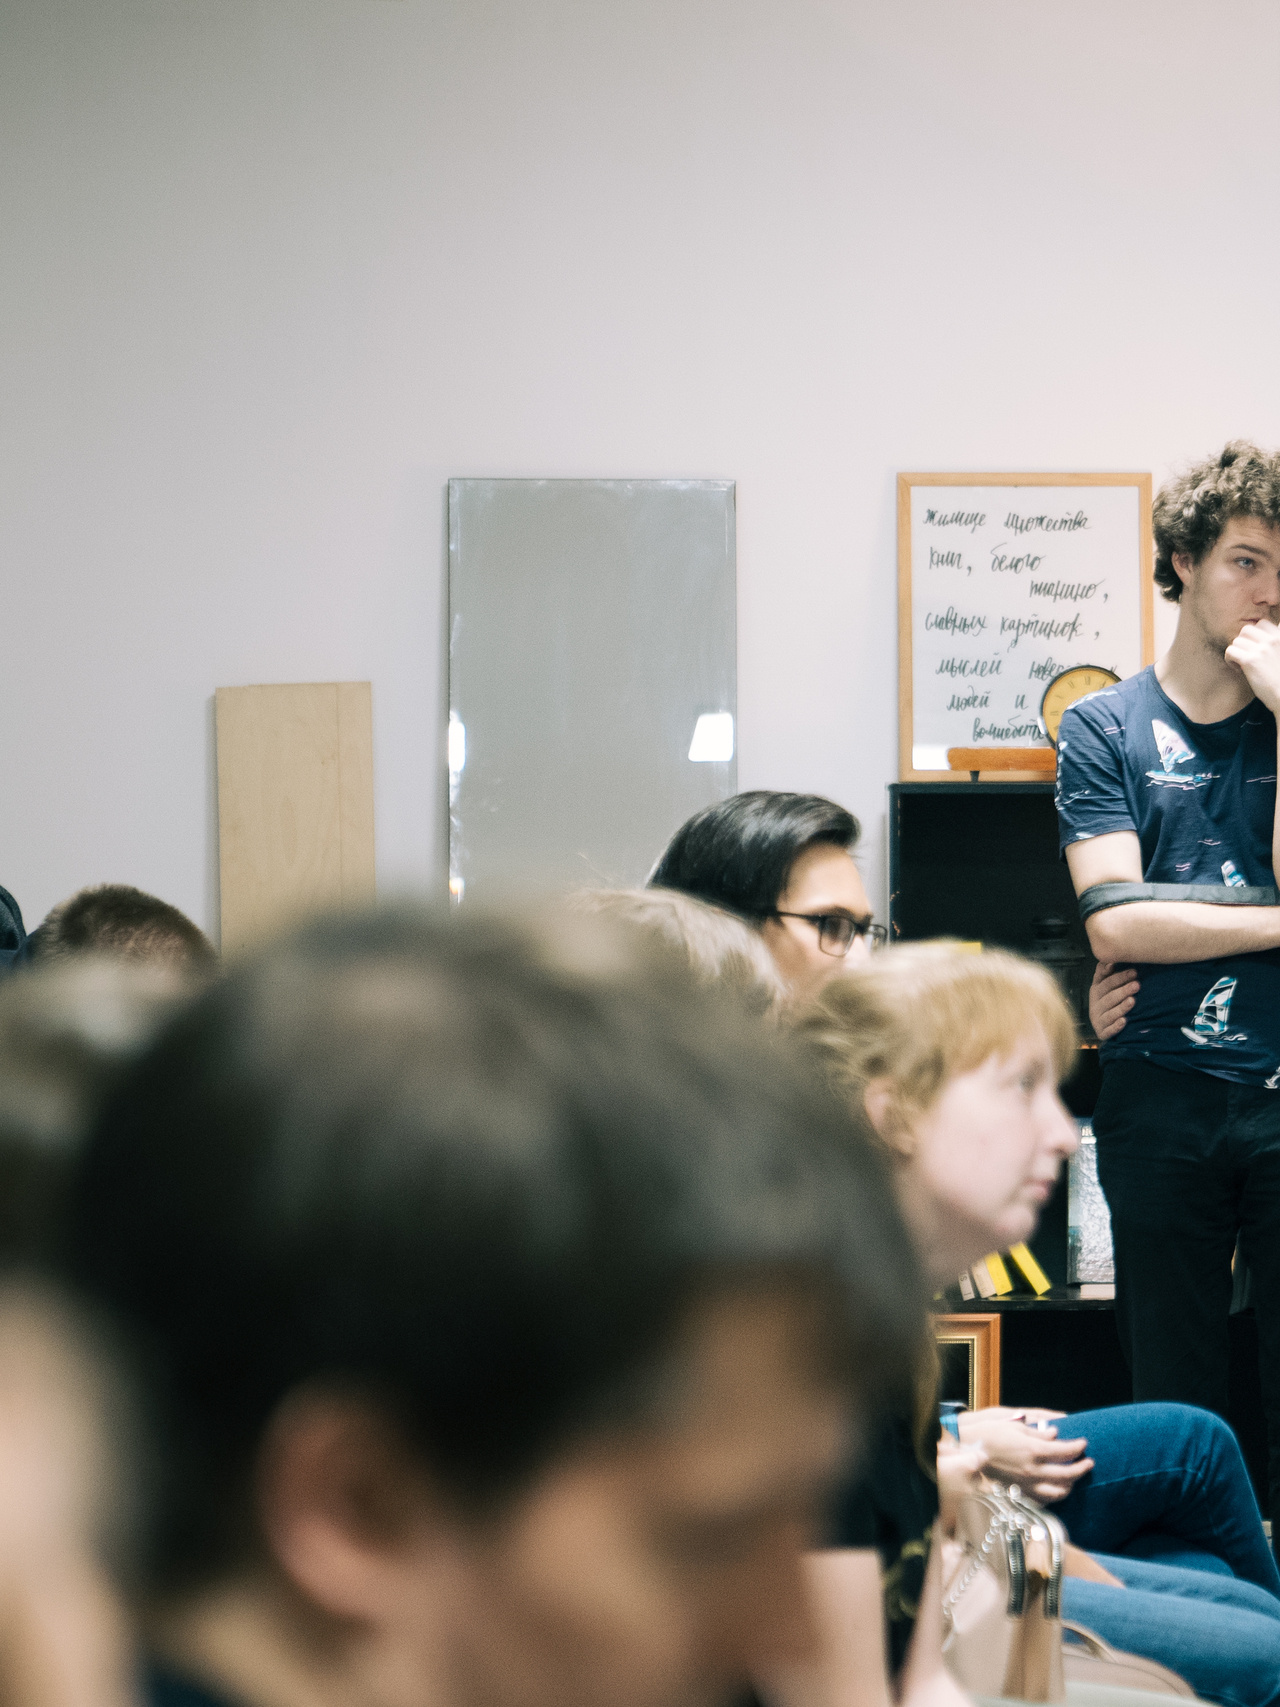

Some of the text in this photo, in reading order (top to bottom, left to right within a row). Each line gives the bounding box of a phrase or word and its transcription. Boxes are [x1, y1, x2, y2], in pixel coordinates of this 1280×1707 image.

[990, 543, 1046, 574] белого
[925, 606, 988, 637] славных
[935, 652, 1002, 678] мыслей
[946, 685, 1029, 711] людей и
